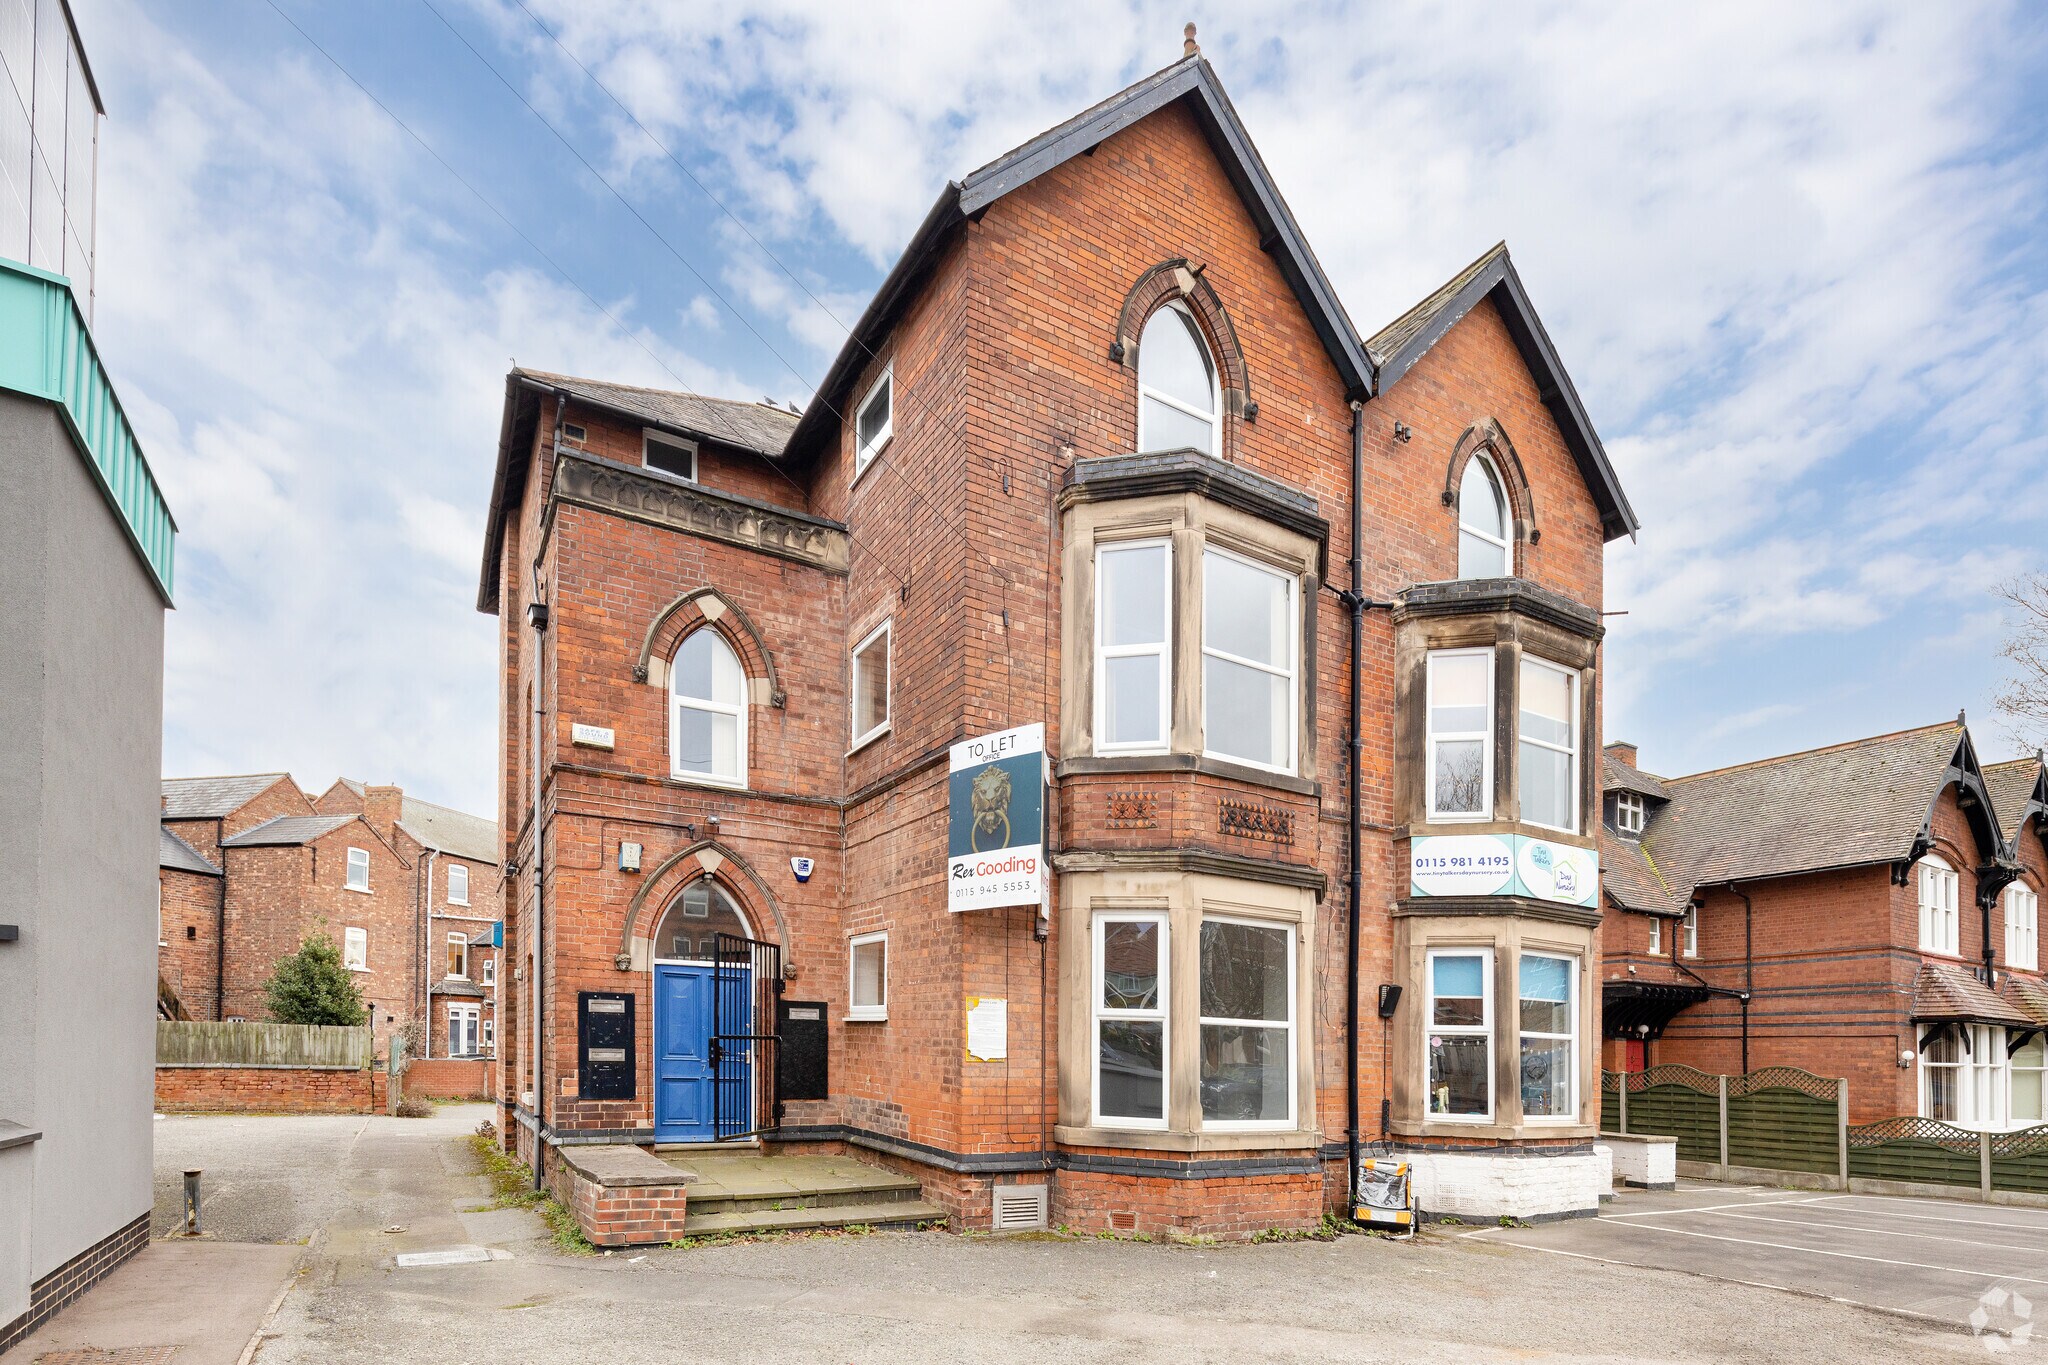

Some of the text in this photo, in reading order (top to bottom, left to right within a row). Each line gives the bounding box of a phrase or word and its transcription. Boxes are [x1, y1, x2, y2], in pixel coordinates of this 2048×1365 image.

[967, 734, 1017, 759] TO LET
[982, 752, 1001, 762] OFFICE
[952, 856, 1036, 881] Rex Gooding
[1415, 856, 1509, 868] 0115 981 4195
[1415, 869, 1510, 877] www.tinytalkersdaynursery.co.uk
[1559, 871, 1572, 885] Day
[956, 887, 975, 898] 0115
[979, 884, 998, 895] 945
[1003, 880, 1030, 892] 5553
[1556, 880, 1576, 896] Nursery
